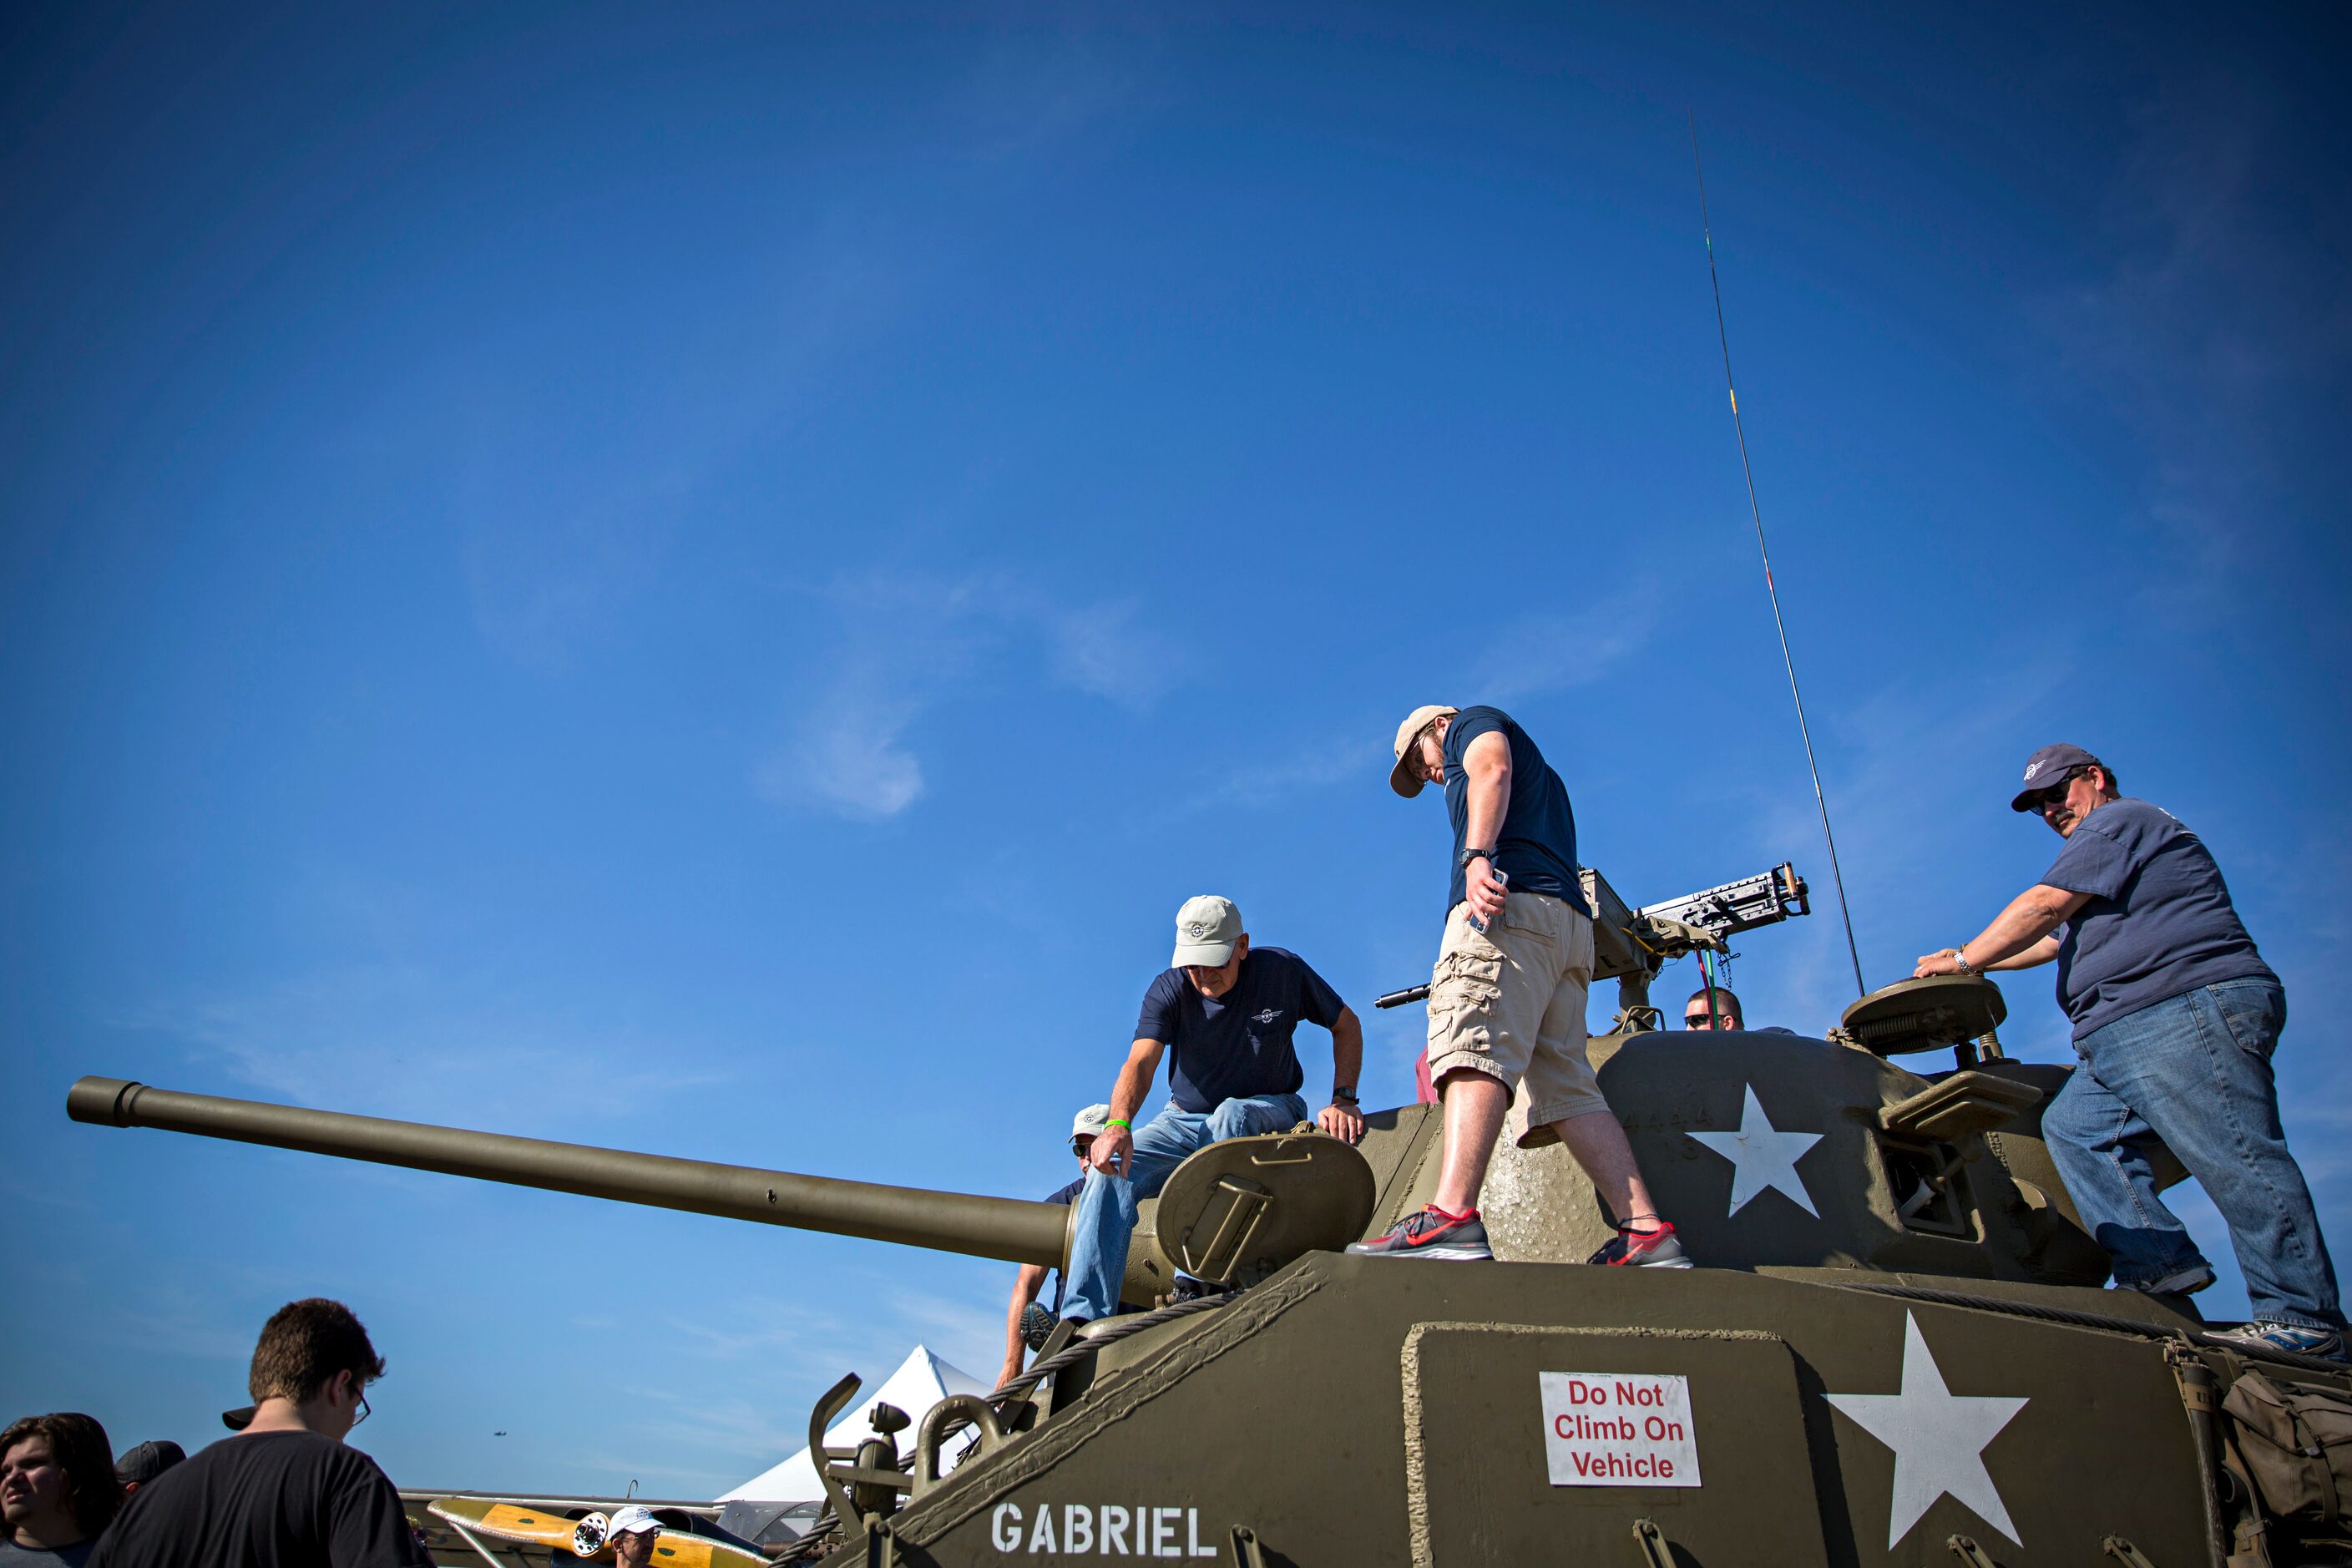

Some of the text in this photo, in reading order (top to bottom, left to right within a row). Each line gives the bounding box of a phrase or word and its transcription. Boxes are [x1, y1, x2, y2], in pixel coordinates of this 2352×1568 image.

[1569, 1380, 1664, 1407] Do Not
[1555, 1414, 1684, 1441] Climb On
[1571, 1452, 1673, 1479] Vehicle
[992, 1502, 1217, 1557] GABRIEL
